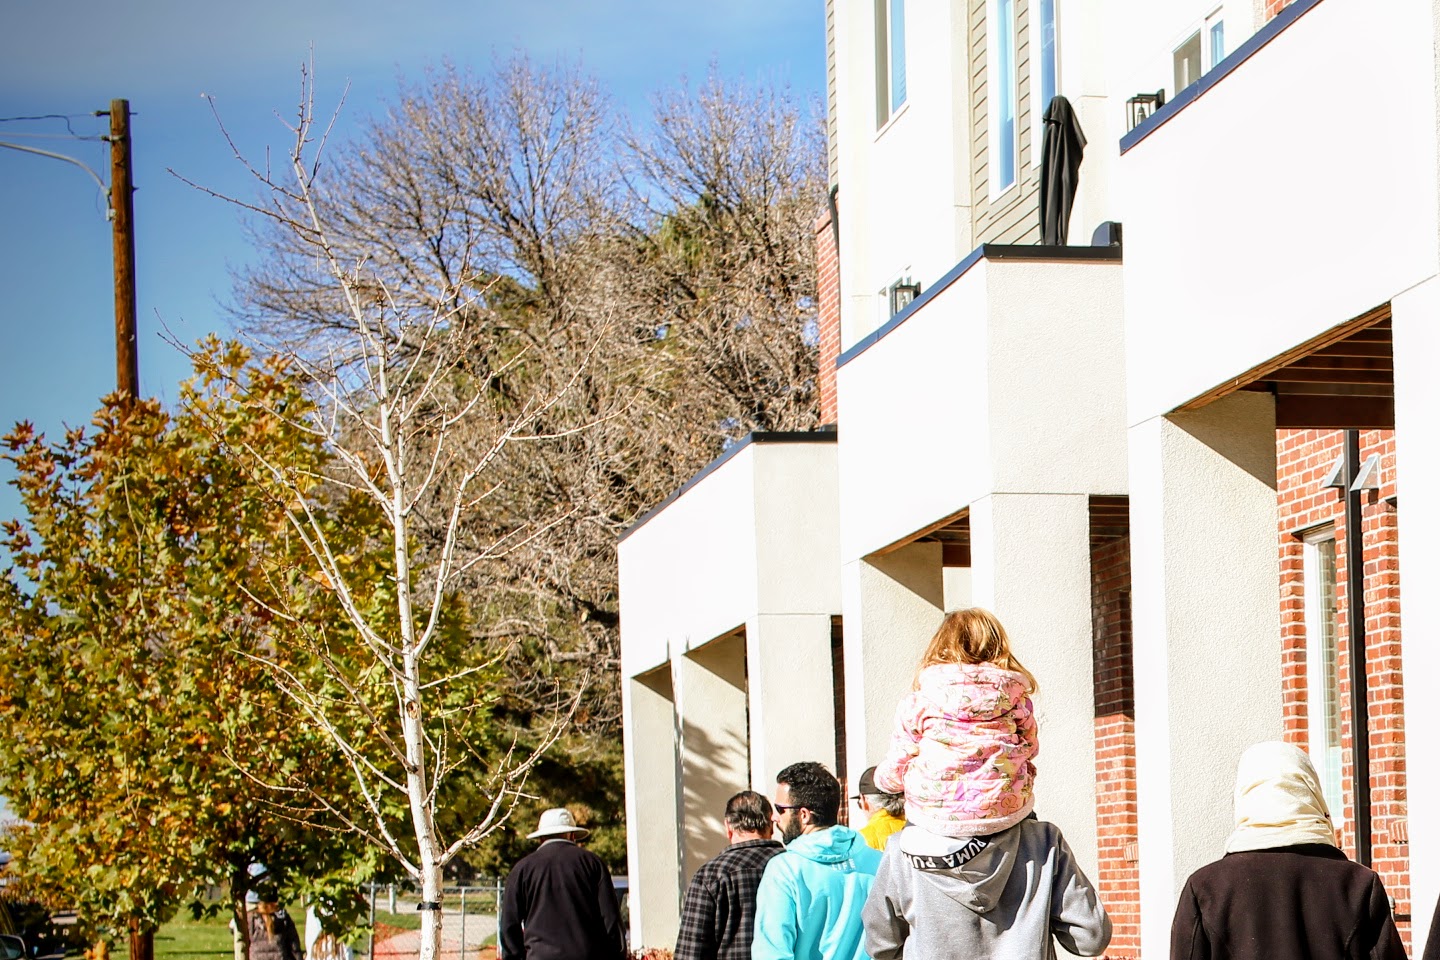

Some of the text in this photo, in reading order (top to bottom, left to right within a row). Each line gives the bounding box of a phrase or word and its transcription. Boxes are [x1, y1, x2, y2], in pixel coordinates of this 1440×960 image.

[903, 838, 986, 868] PUMA PUM
[832, 858, 855, 871] LIFE
